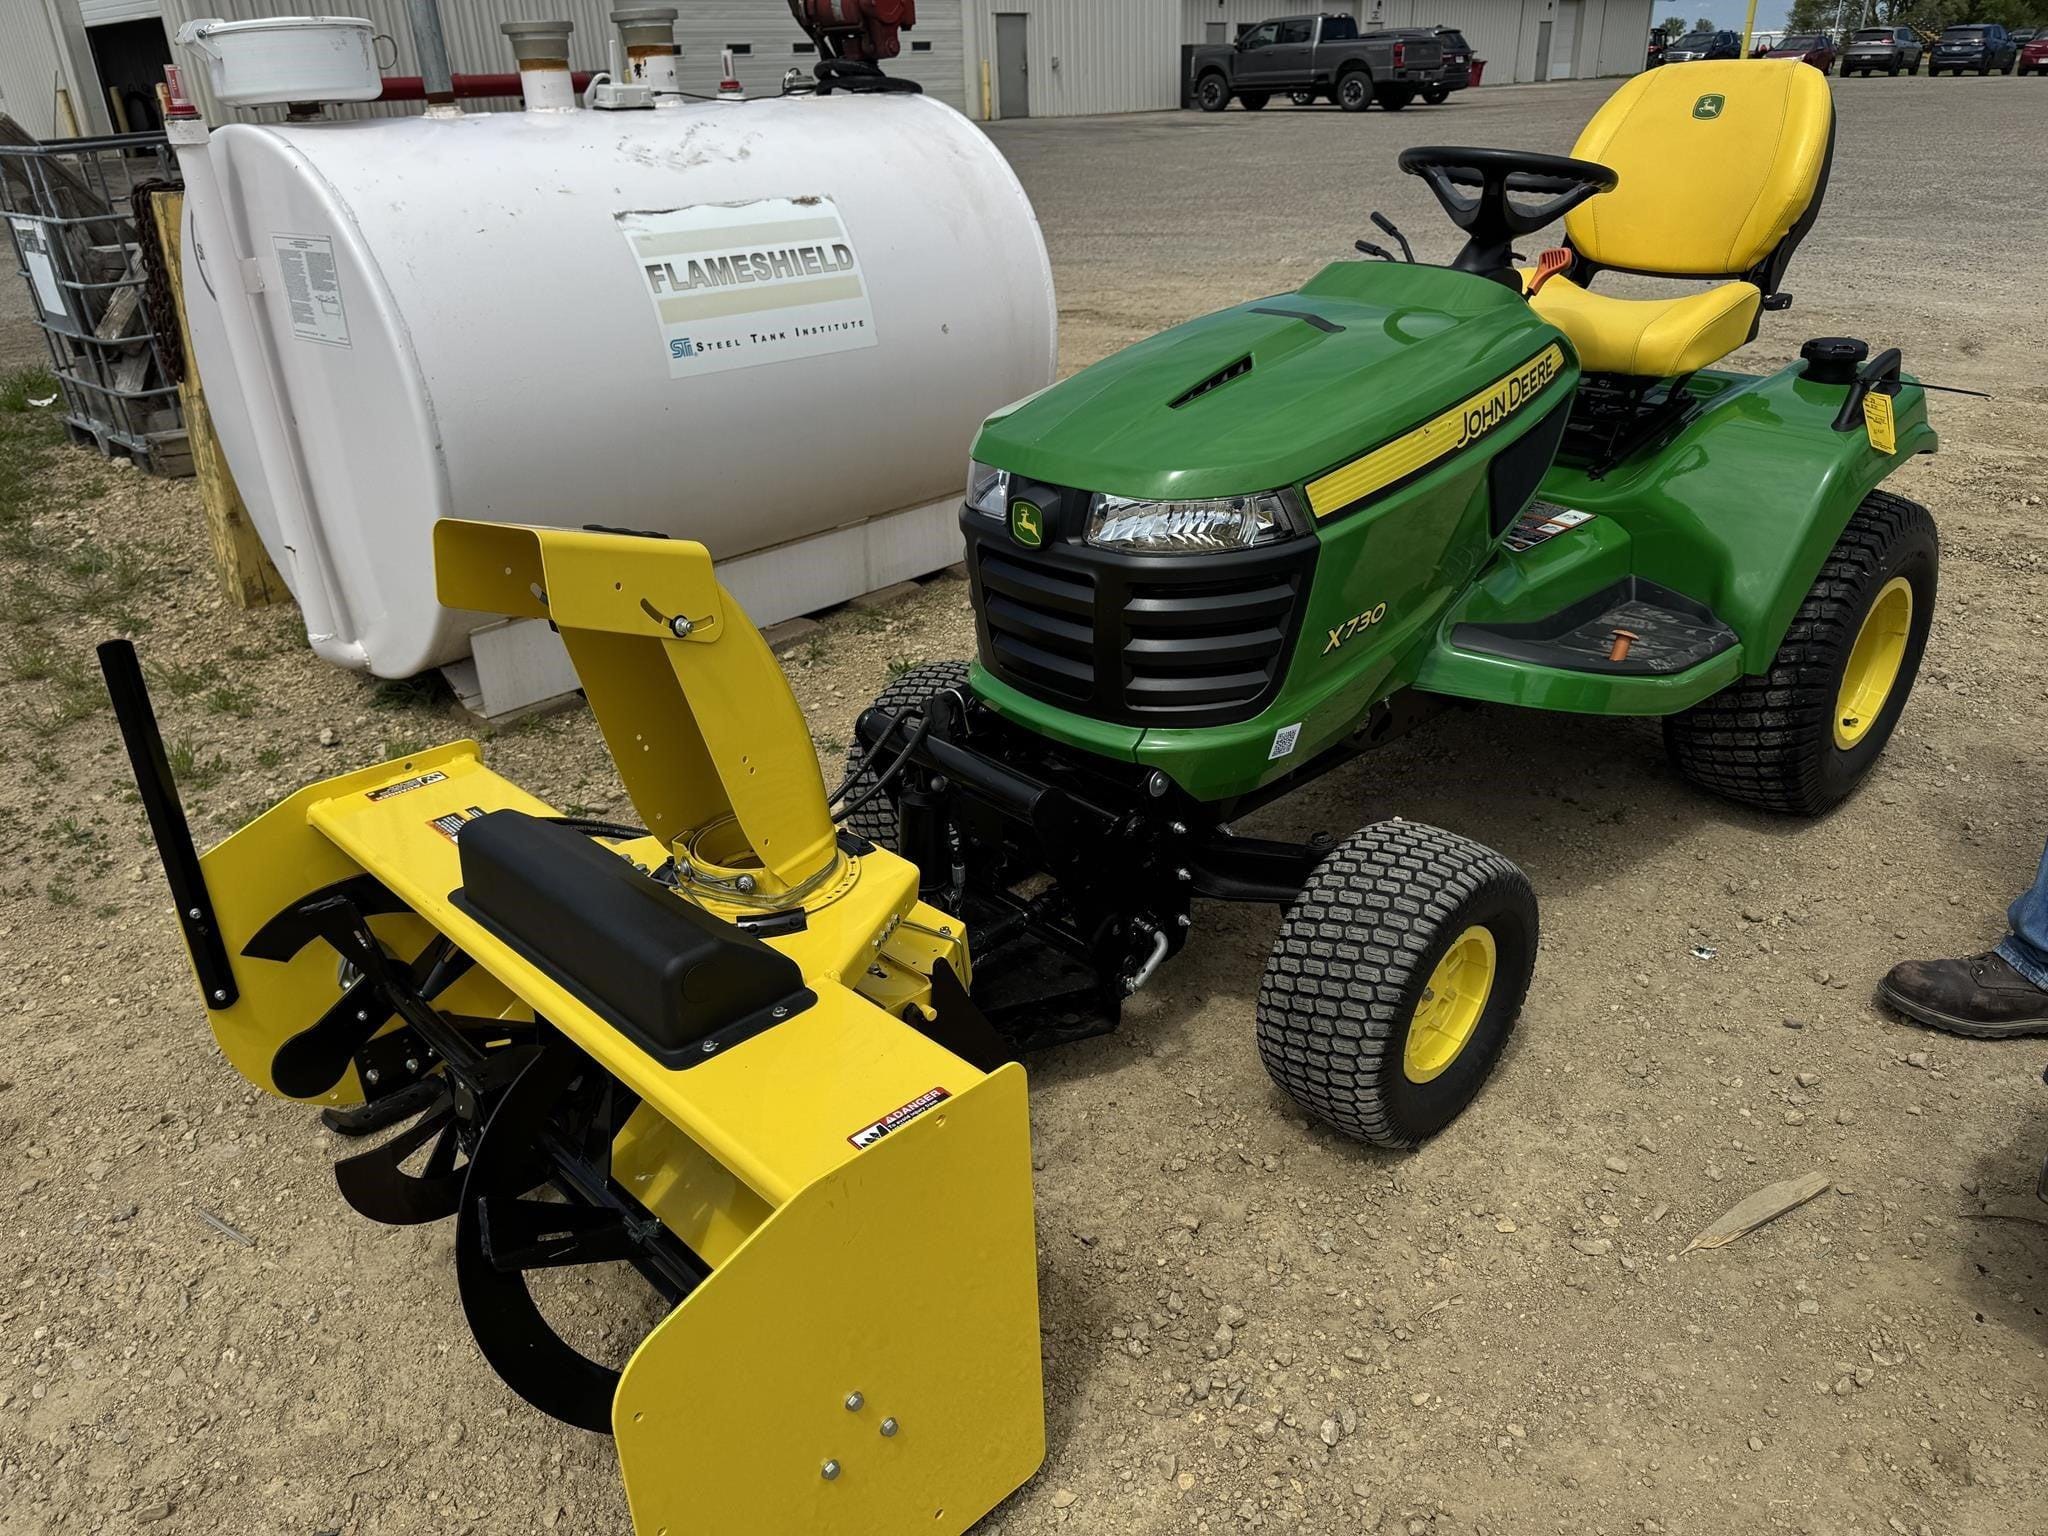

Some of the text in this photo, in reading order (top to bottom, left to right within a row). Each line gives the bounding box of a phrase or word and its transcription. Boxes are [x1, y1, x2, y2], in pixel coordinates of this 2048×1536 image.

[644, 243, 854, 293] FLAMESHIELD
[1457, 391, 1506, 446] JOHN
[1320, 601, 1387, 657] X730
[892, 1090, 941, 1118] DANGER
